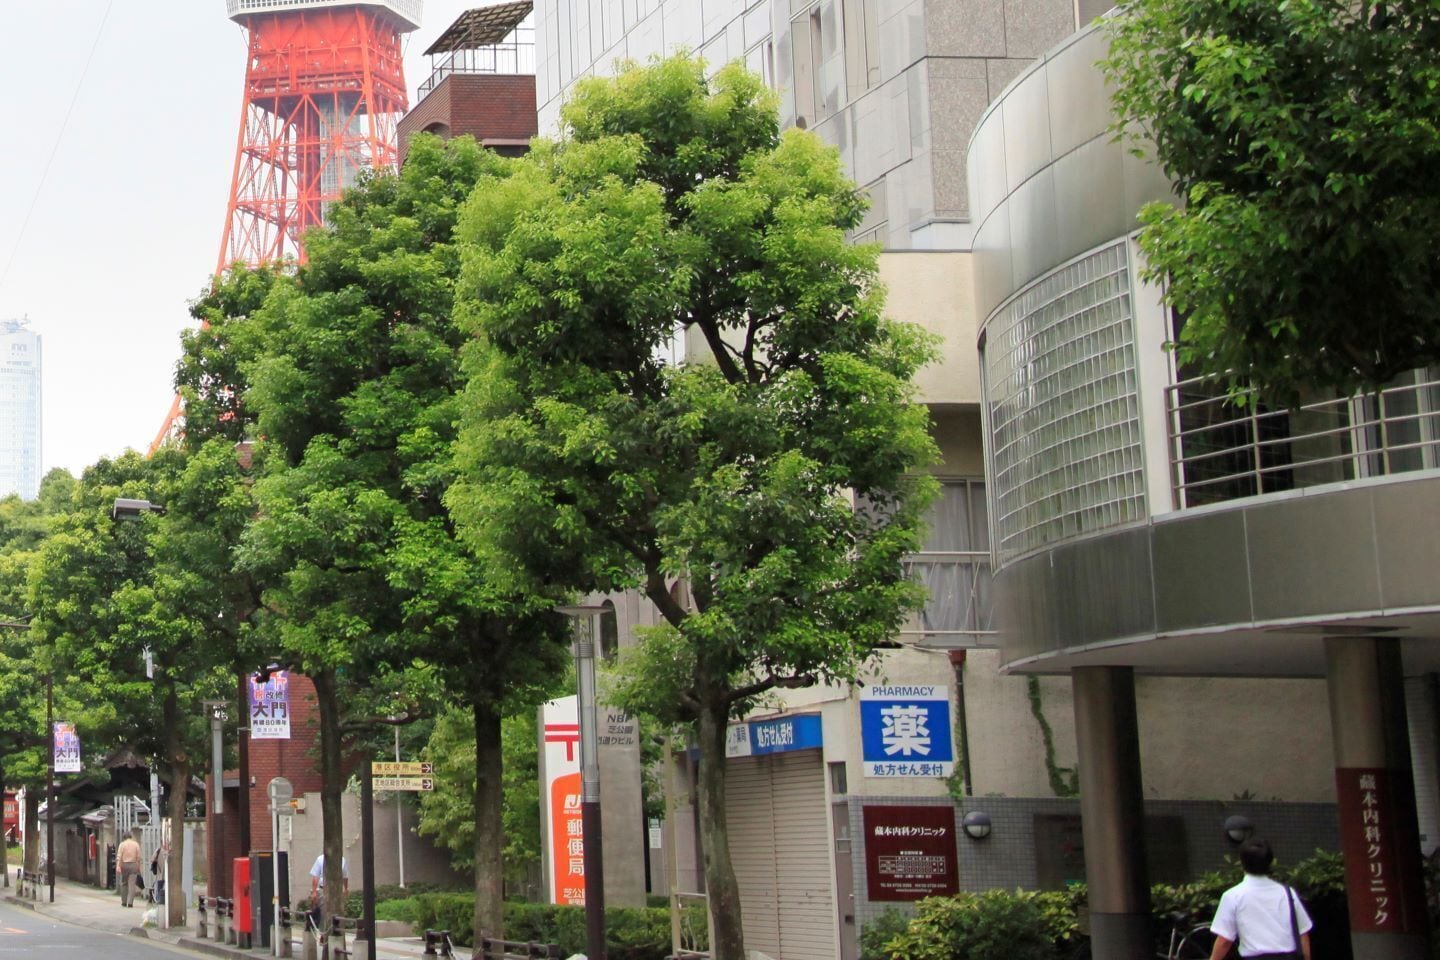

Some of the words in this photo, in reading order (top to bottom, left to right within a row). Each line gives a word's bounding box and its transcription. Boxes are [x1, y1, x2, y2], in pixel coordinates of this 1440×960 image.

[872, 686, 934, 697] PHARMACY
[253, 701, 287, 718] 大門
[756, 722, 793, 748] 処方せん受付
[880, 704, 931, 756] 薬
[56, 747, 78, 758] 大門
[873, 763, 944, 776] 処方せん受付
[566, 818, 584, 876] 郵便局
[563, 888, 585, 898] 芝公
